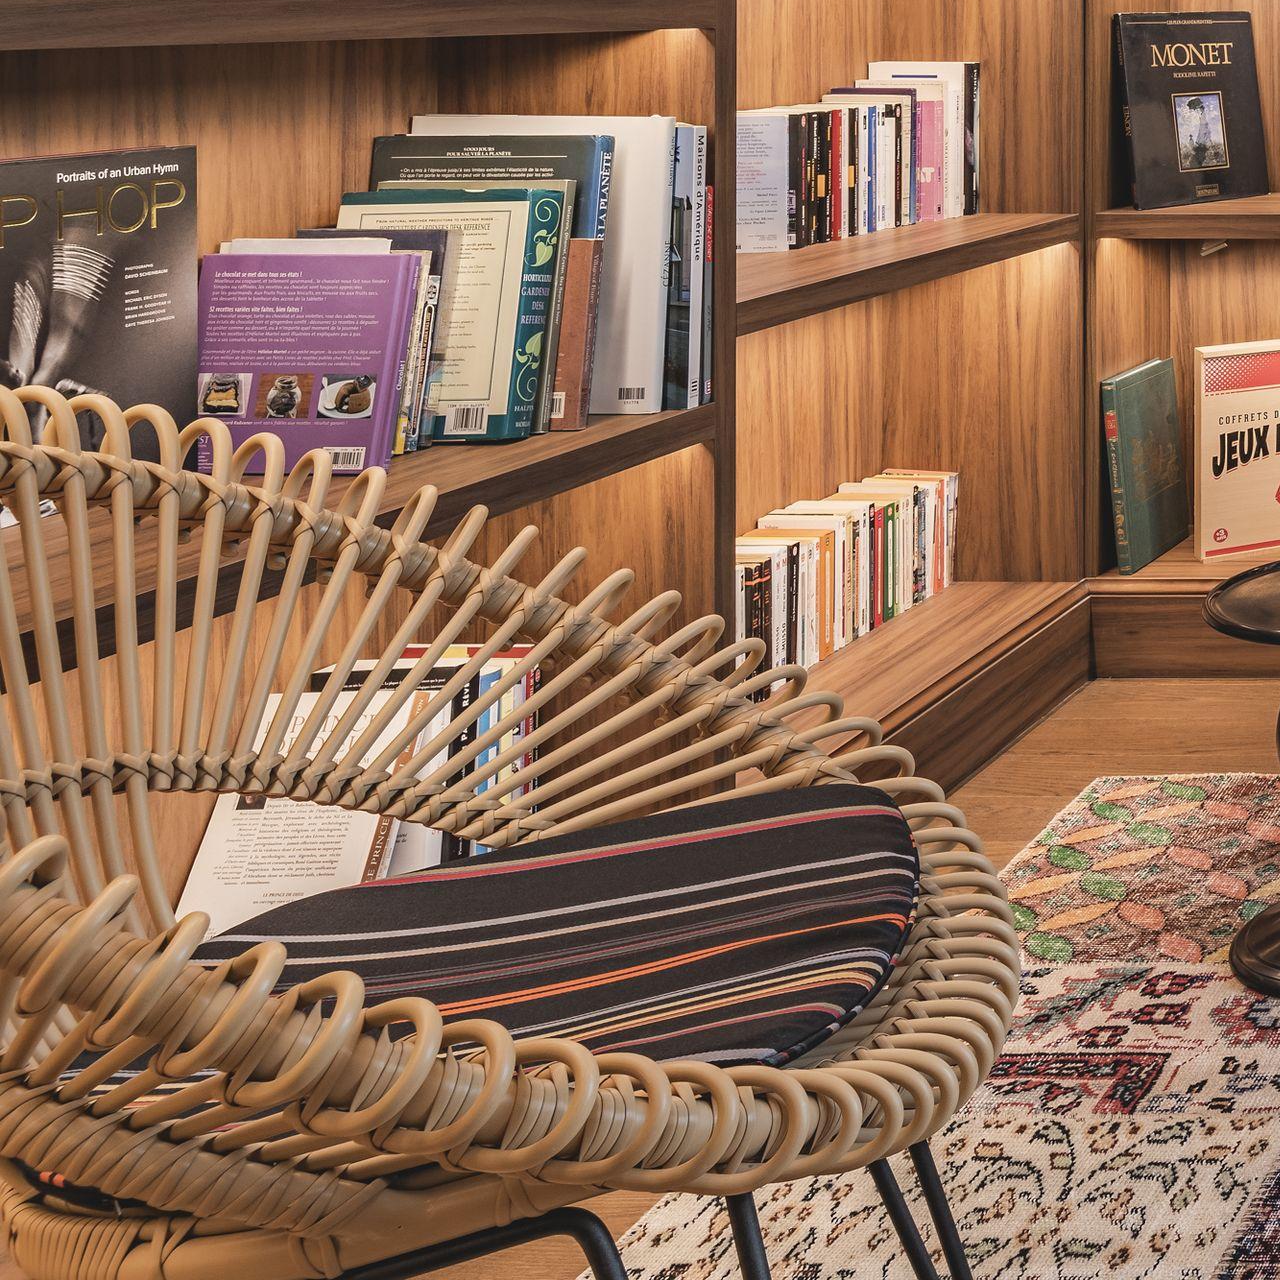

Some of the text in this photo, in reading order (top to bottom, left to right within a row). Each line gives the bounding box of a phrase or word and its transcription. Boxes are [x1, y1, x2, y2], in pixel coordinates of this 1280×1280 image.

[1150, 42, 1233, 67] MONET
[56, 163, 179, 184] Portraits of an Urban Hymn
[598, 152, 613, 231] LA PLANÈTE
[694, 135, 705, 261] Maisons d'Amérique
[56, 178, 186, 241] HOP
[662, 240, 671, 288] CÉZANNE
[396, 363, 406, 391] Chocolat
[1218, 412, 1269, 425] COFFRETS
[1212, 424, 1270, 478] JEUX
[365, 818, 390, 883] LE PRINCE
